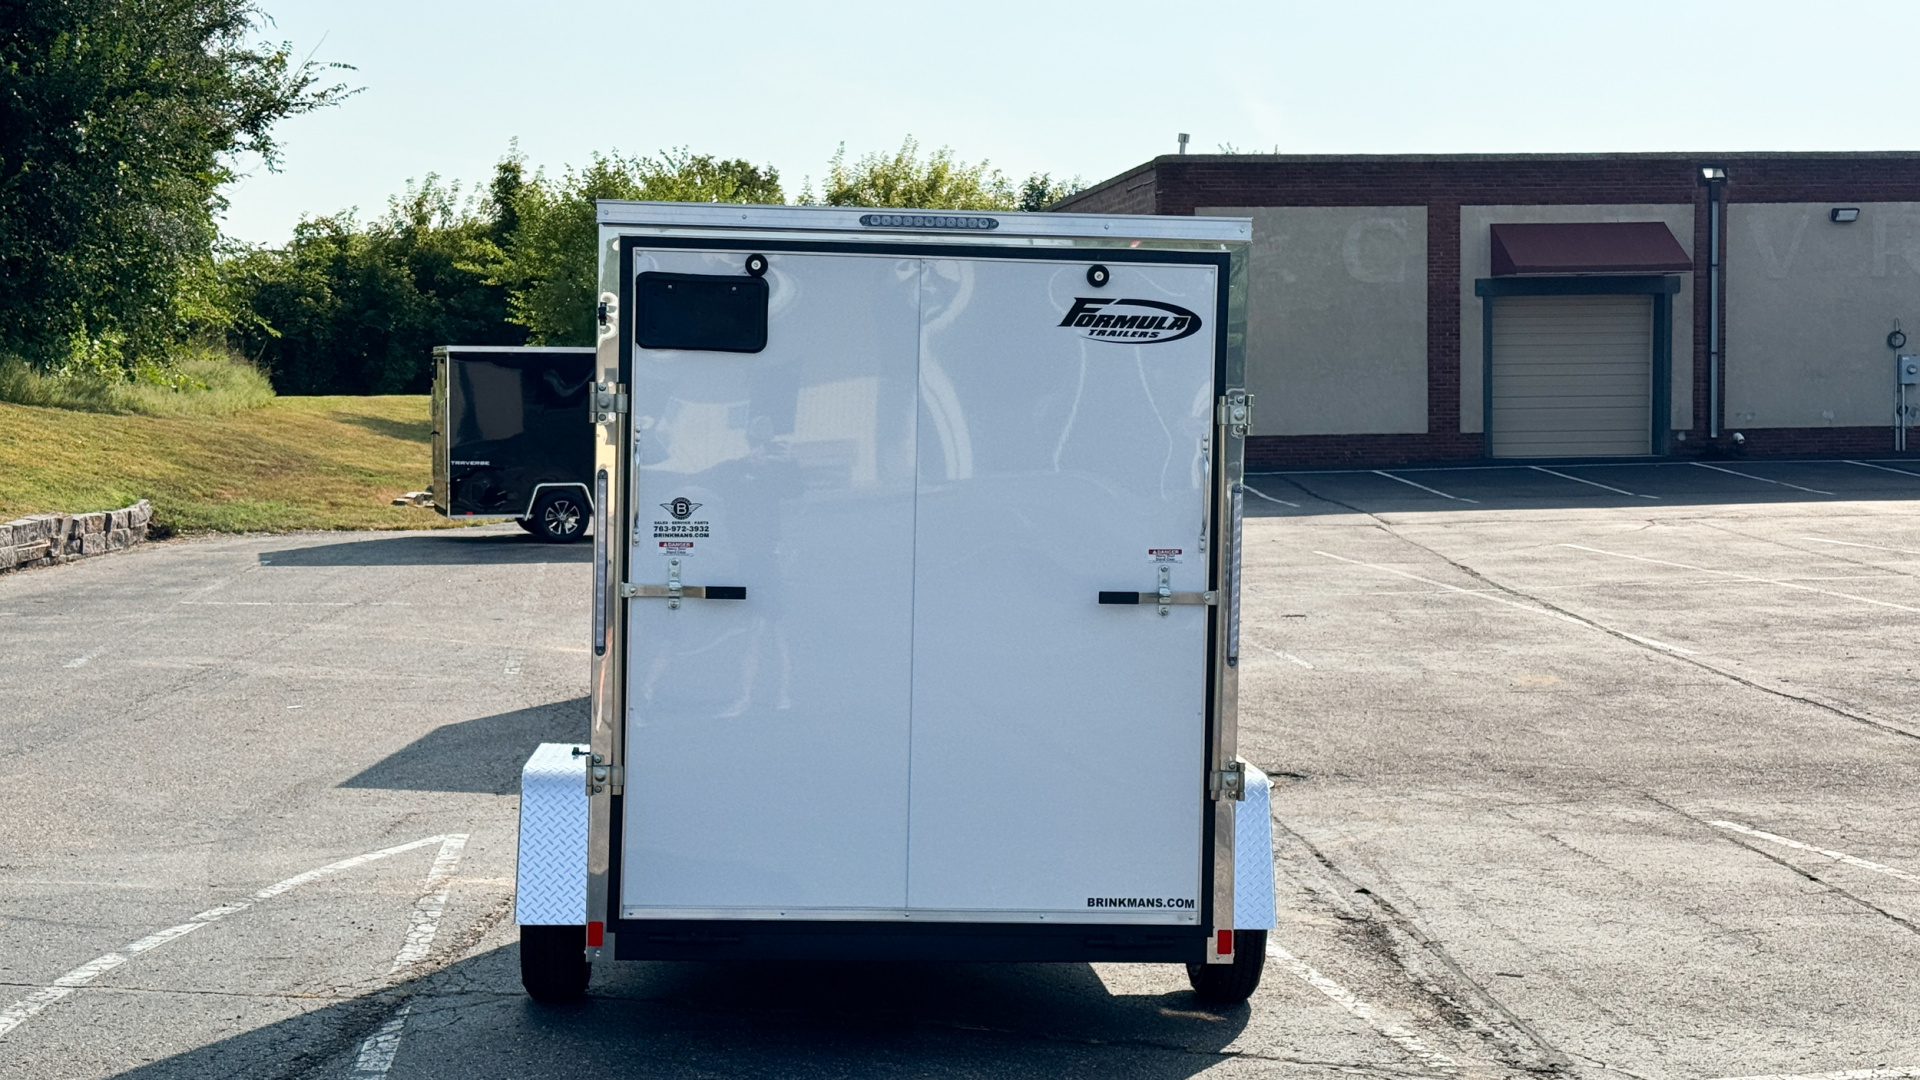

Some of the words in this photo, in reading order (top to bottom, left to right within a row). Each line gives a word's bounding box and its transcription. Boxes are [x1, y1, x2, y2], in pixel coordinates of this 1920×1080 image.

[1057, 297, 1190, 330] FORMULA
[1088, 329, 1160, 338] TRAILERS
[676, 503, 687, 514] B
[1087, 898, 1195, 908] BRINKMANS.COM
